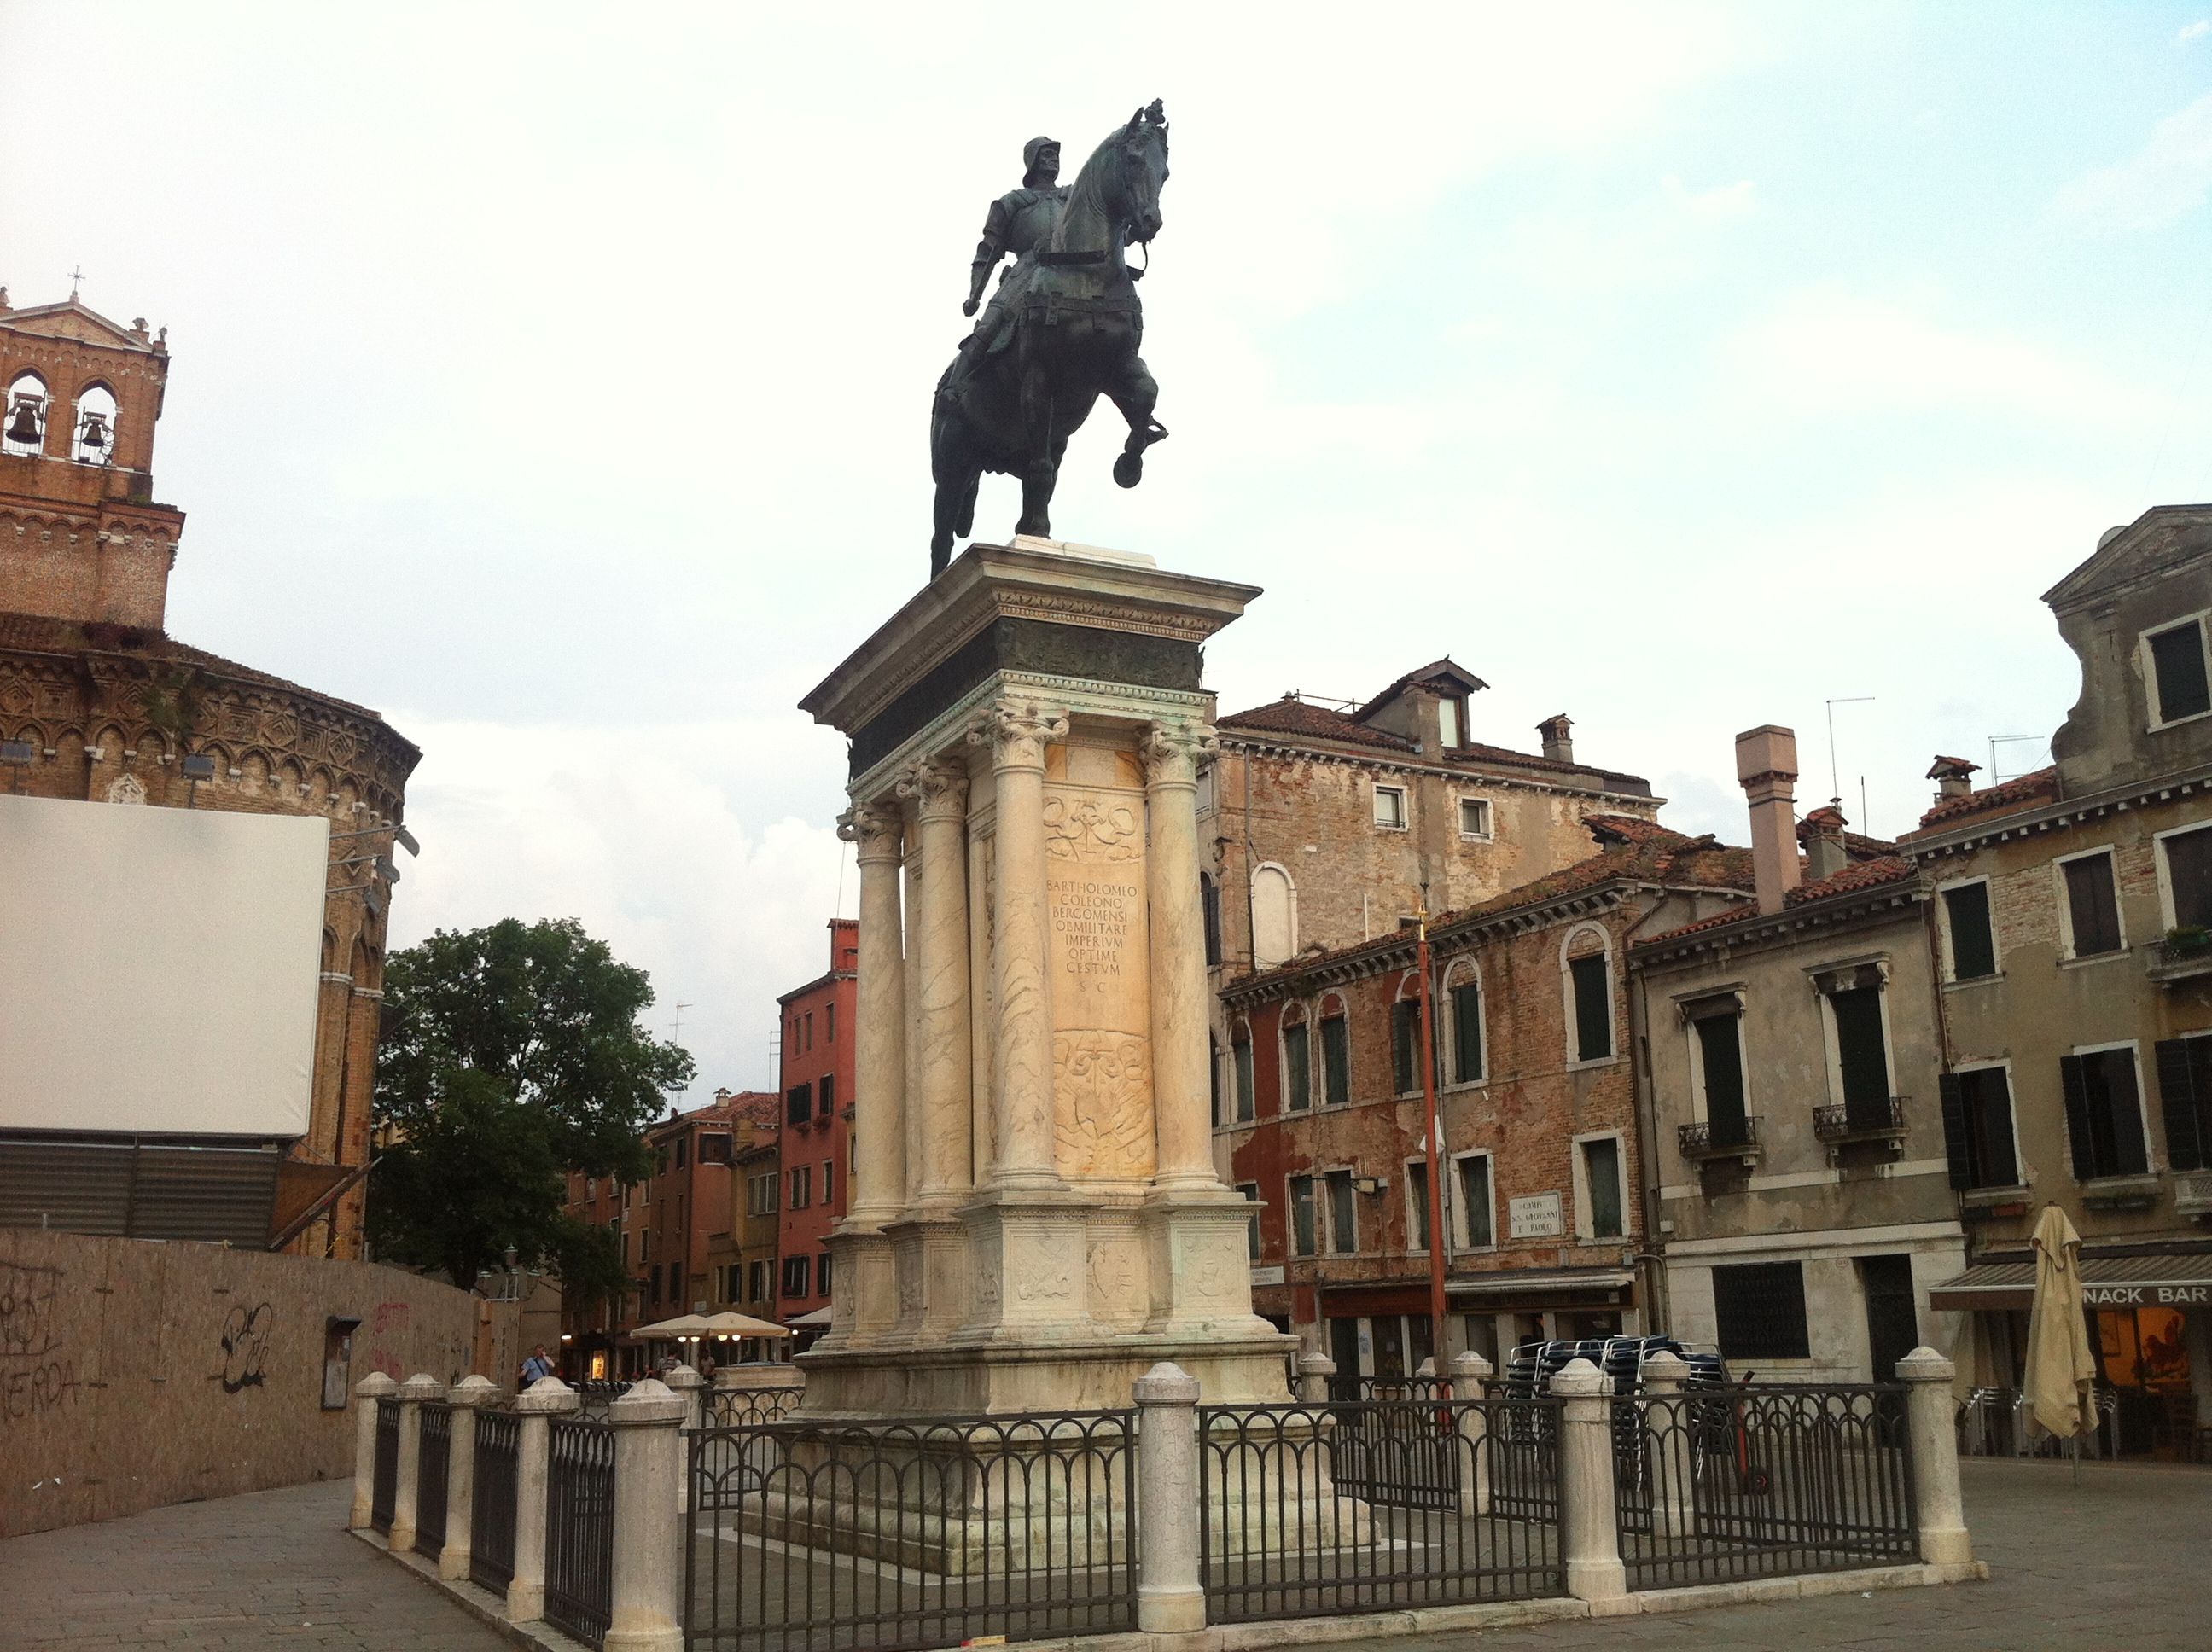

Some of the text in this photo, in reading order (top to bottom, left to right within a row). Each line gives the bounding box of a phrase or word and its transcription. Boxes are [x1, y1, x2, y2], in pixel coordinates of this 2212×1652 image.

[1046, 880, 1137, 897] BARTHOLOMEO
[1061, 894, 1122, 909] COLEONO
[1053, 907, 1127, 922] BERGOMENSI
[1065, 934, 1123, 949] IMPERIVM
[1068, 948, 1117, 962] OPTIME
[1067, 963, 1121, 975] GESTVM
[2157, 1287, 2208, 1303] BAR
